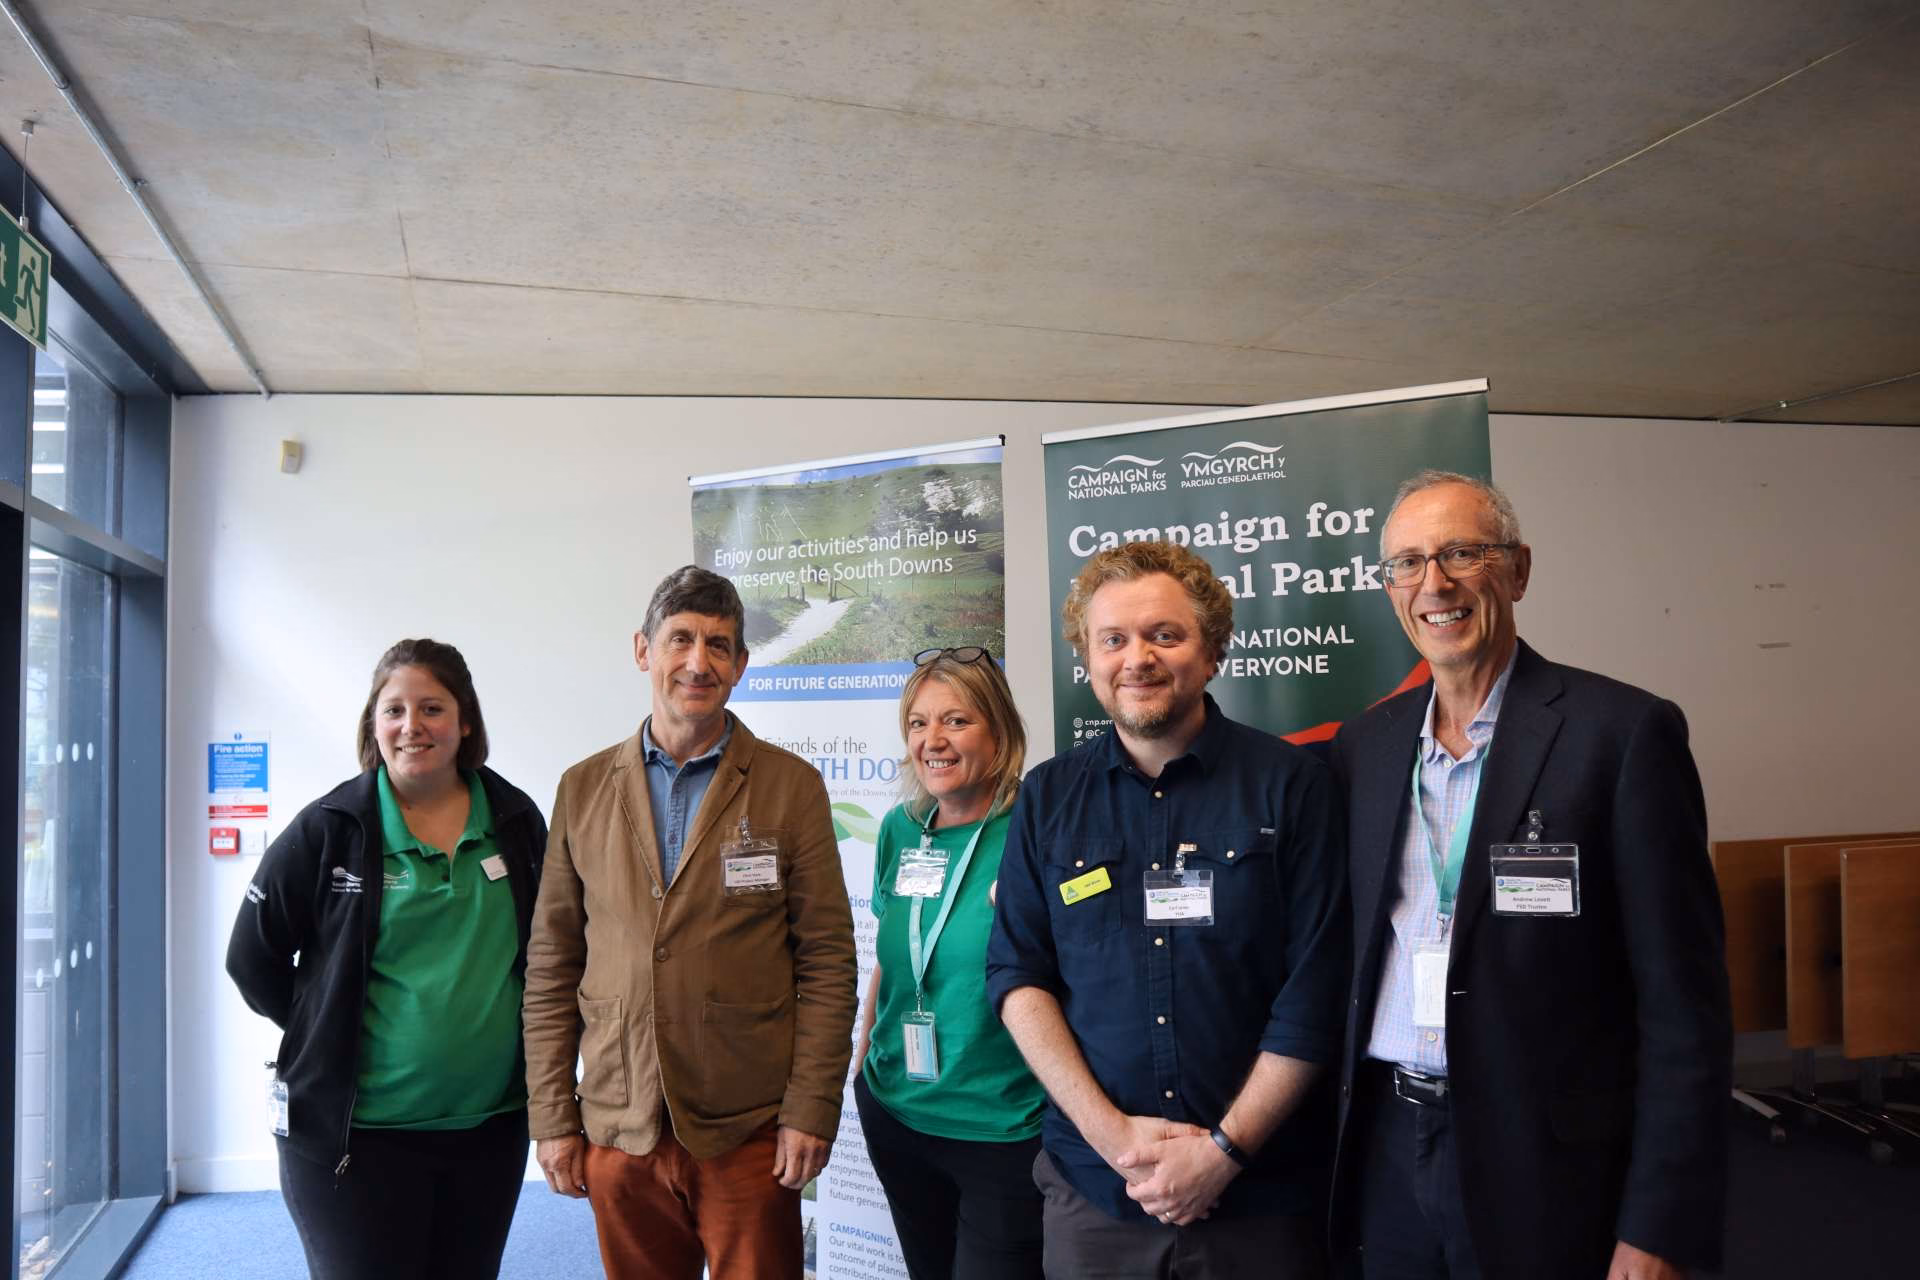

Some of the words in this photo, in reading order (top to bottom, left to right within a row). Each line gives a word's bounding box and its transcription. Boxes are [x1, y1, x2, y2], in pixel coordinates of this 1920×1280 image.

[1181, 454, 1274, 478] YMGYRCH
[1278, 457, 1285, 468] y
[1068, 467, 1148, 489] CAMPAIGN
[1152, 470, 1166, 480] for
[1181, 478, 1215, 488] PARCIAU
[1217, 470, 1286, 485] CENEDLAETHOL
[1068, 485, 1127, 501] NATIONAL
[1130, 479, 1167, 494] PARKS
[1306, 501, 1375, 537] for
[715, 548, 752, 569] Enjoy
[756, 546, 784, 562] our
[788, 538, 864, 559] activities
[869, 529, 900, 552] and
[907, 526, 948, 551] help
[954, 528, 977, 544] us
[801, 564, 829, 583] the
[833, 558, 884, 581] South
[889, 556, 953, 577] Downs
[1229, 624, 1355, 650] NATIONAL
[1216, 654, 1330, 678] VERYONE
[748, 678, 773, 691] FOR
[775, 677, 825, 690] FUTURE
[828, 674, 909, 689] GENERATION
[823, 736, 839, 754] of
[843, 736, 867, 754] the
[835, 1139, 863, 1150] upport
[841, 1150, 859, 1163] help
[830, 1162, 873, 1179] enjoyment
[830, 1176, 839, 1185] to
[841, 1179, 876, 1194] preserve
[830, 1189, 855, 1201] future
[829, 1222, 893, 1247] CAMPAIGNING
[829, 1236, 845, 1248] Our
[847, 1240, 864, 1252] vital
[866, 1247, 885, 1258] work
[887, 1250, 894, 1261] is
[829, 1251, 866, 1266] outcome
[868, 1259, 876, 1269] of
[878, 1264, 909, 1279] plannin
